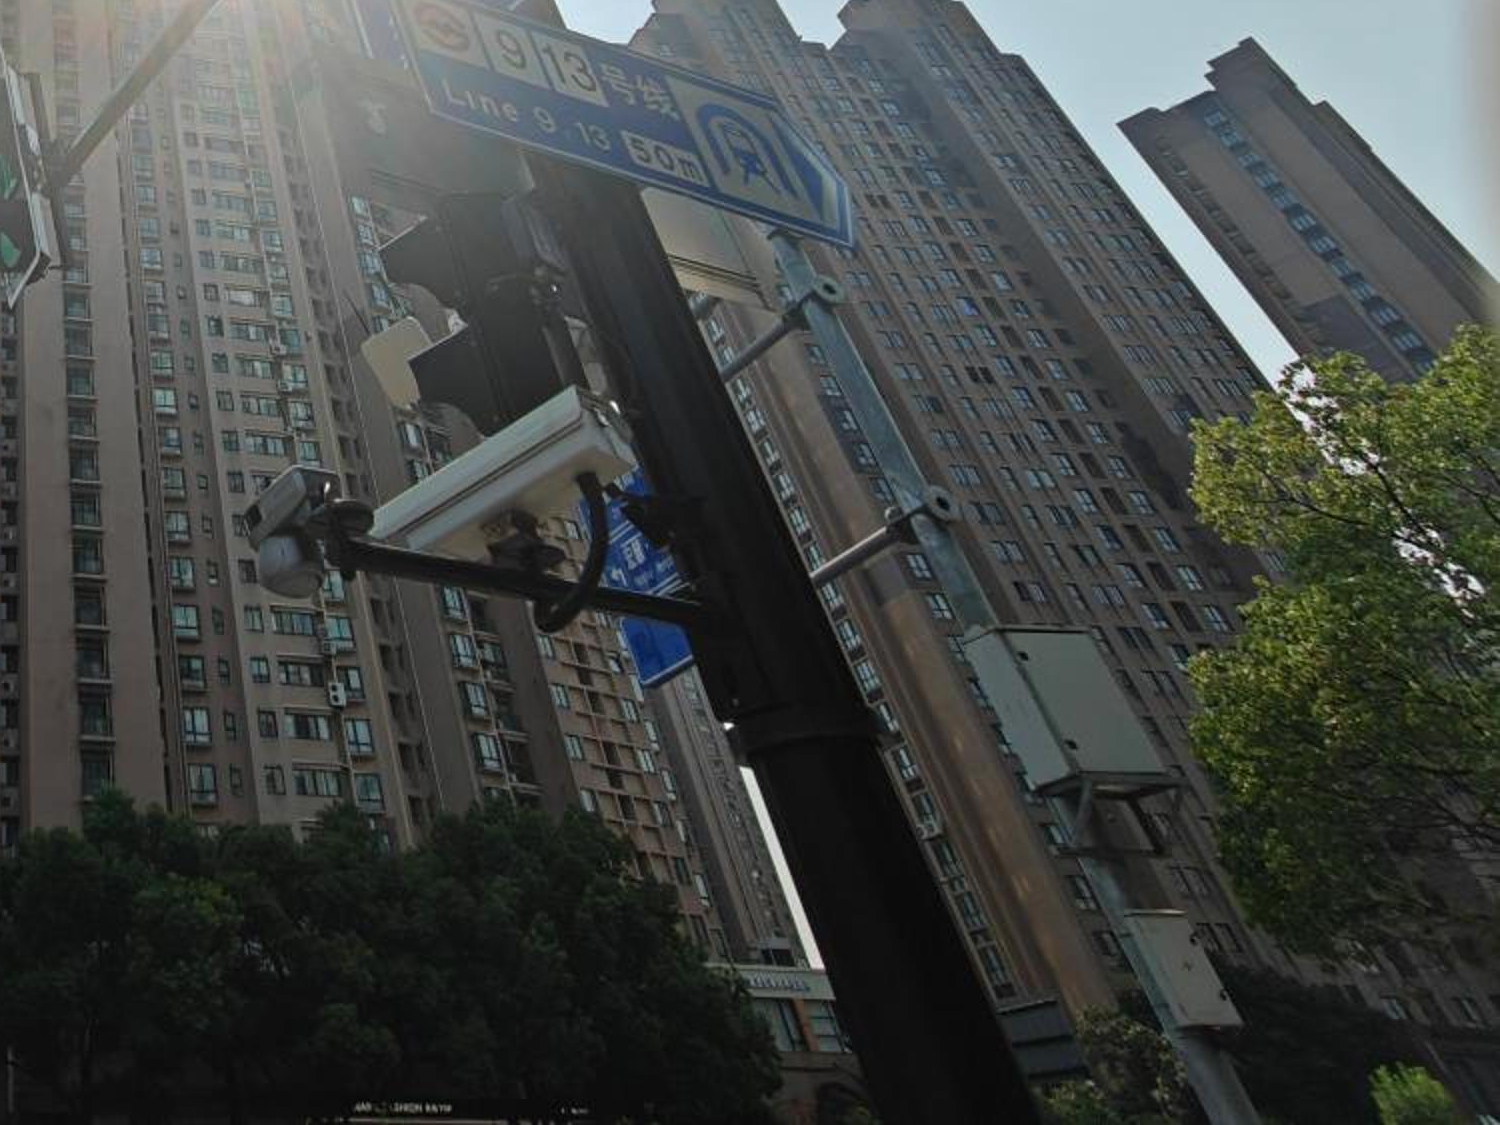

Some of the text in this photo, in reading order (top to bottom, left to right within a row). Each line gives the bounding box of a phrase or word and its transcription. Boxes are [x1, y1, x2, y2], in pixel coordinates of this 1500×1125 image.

[495, 28, 680, 121] 9 13 号线
[442, 78, 612, 154] Line 9 13
[636, 137, 703, 179] 50m
